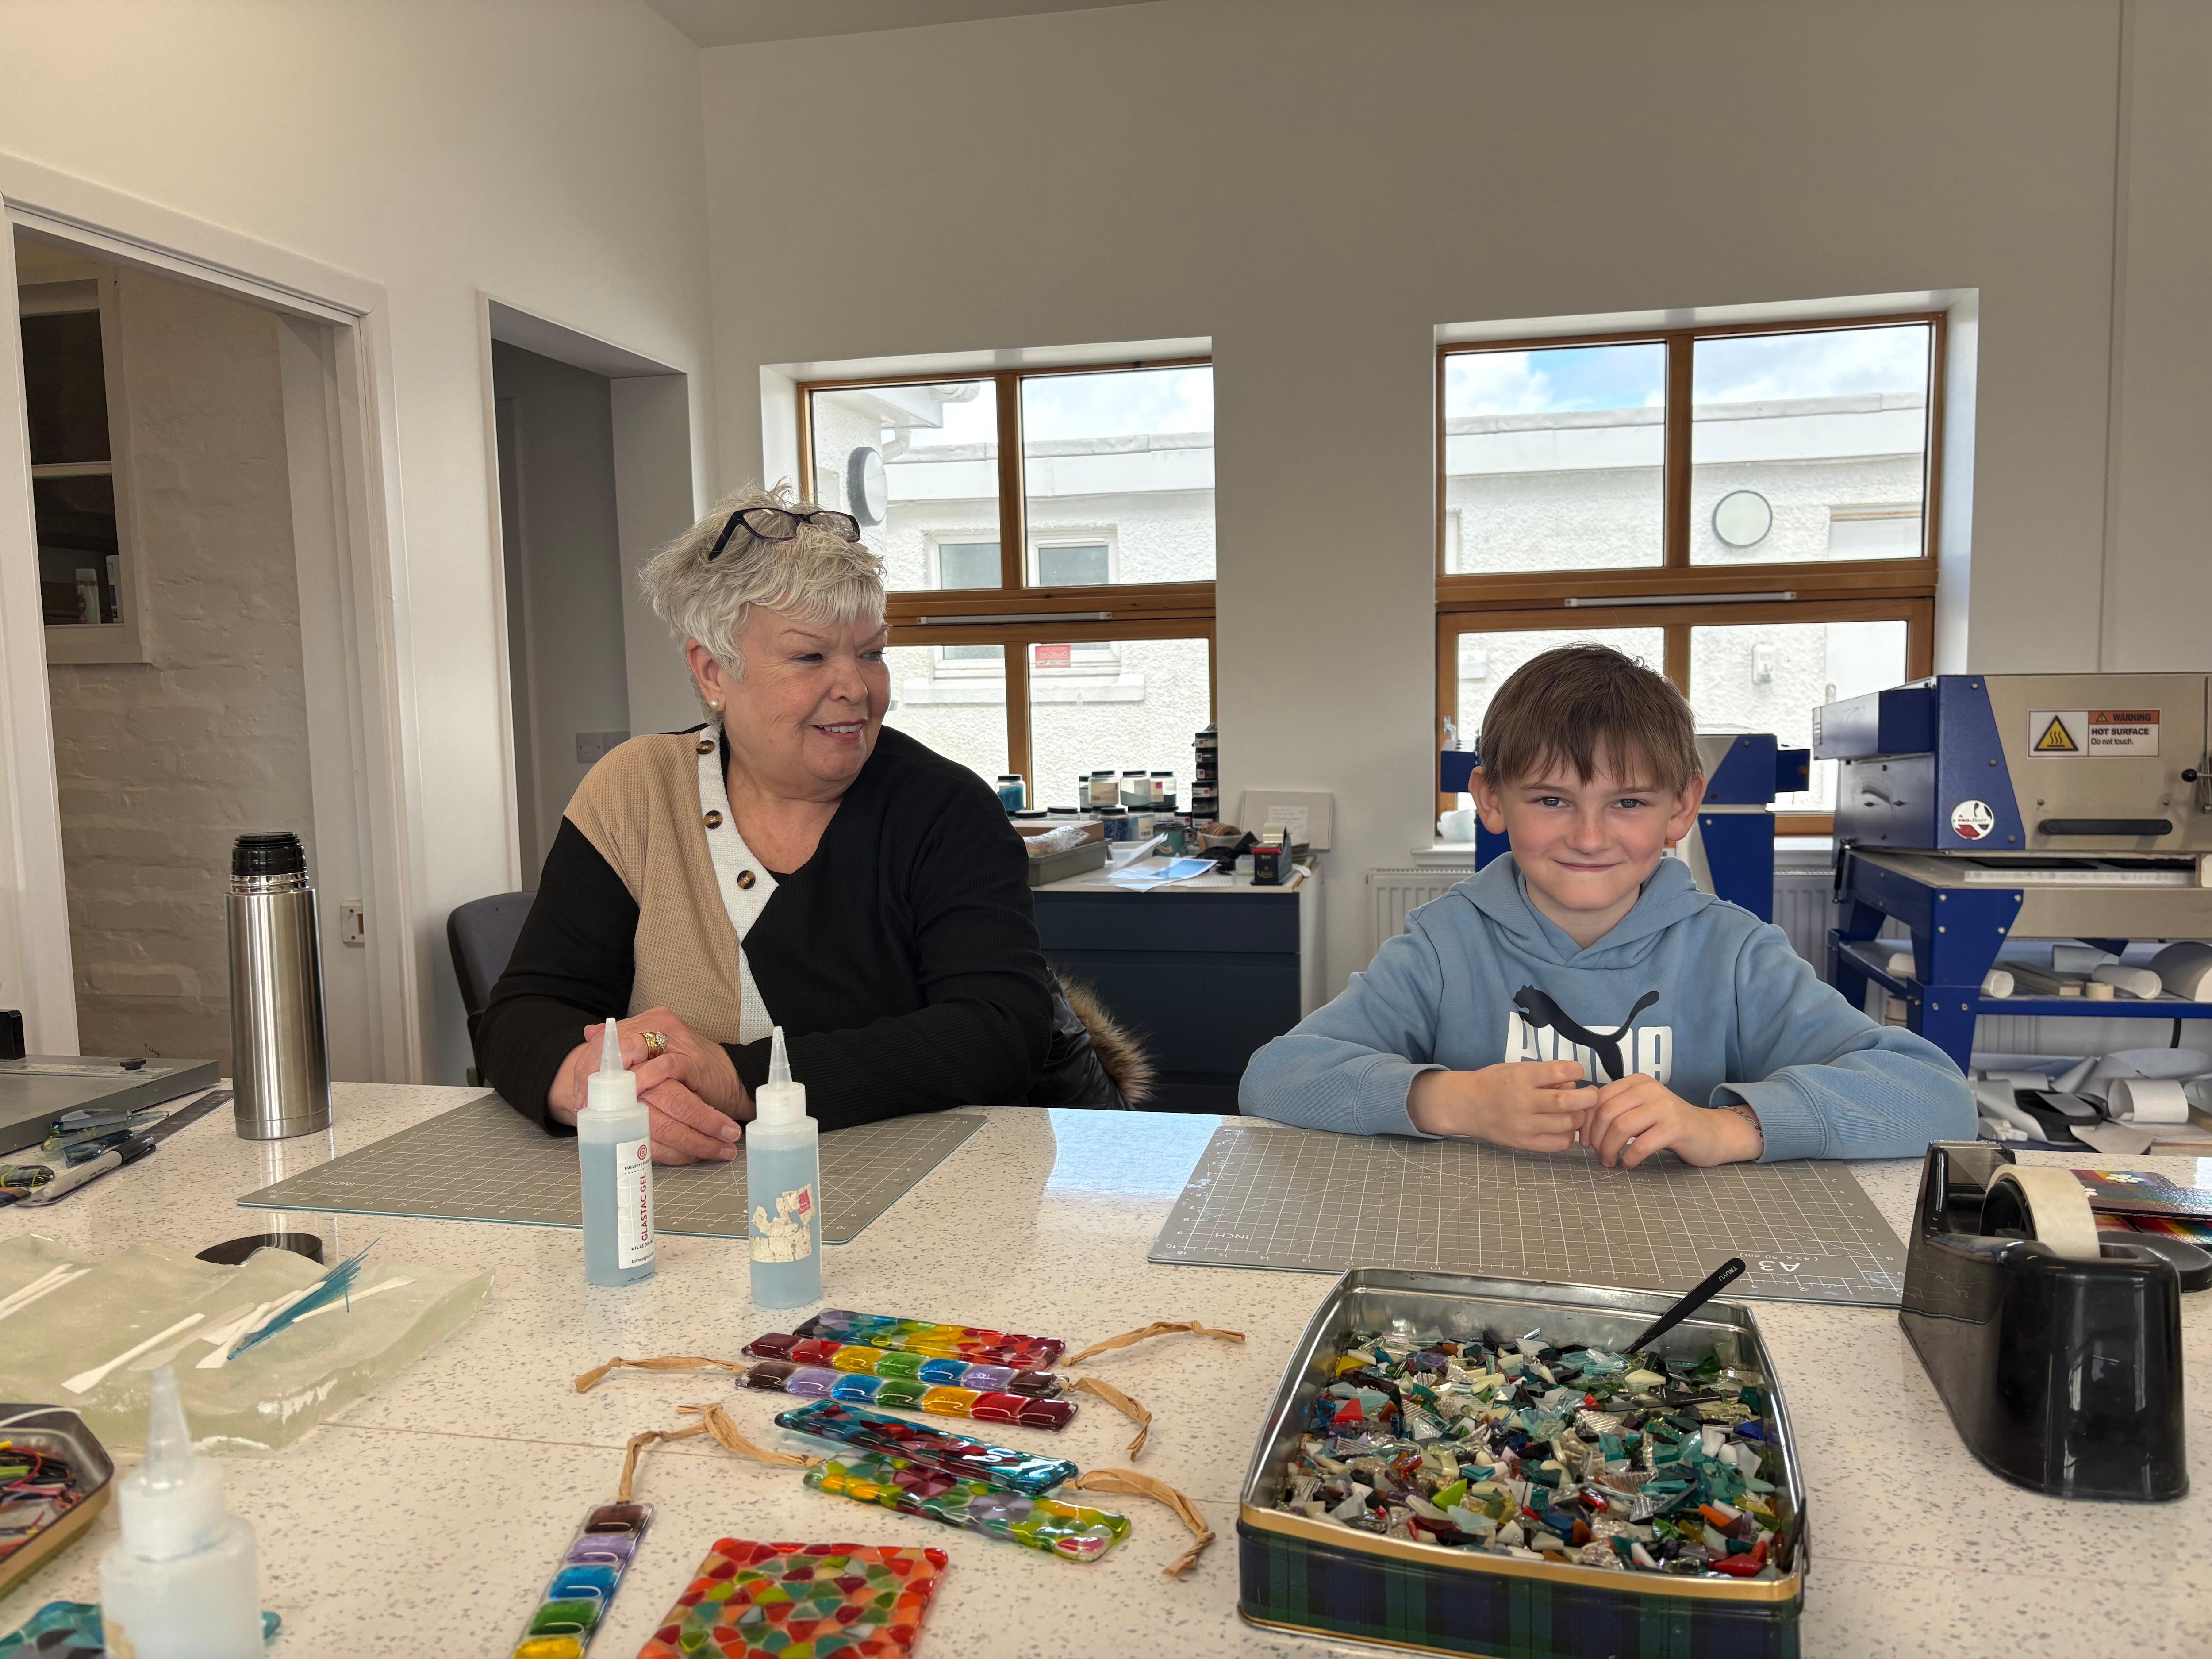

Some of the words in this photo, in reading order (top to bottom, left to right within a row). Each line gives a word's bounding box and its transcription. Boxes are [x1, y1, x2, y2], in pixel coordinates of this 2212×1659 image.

[2113, 713, 2151, 722] WARNING
[1758, 1260, 1801, 1272] A3
[1718, 1266, 1738, 1282] TRUYU
